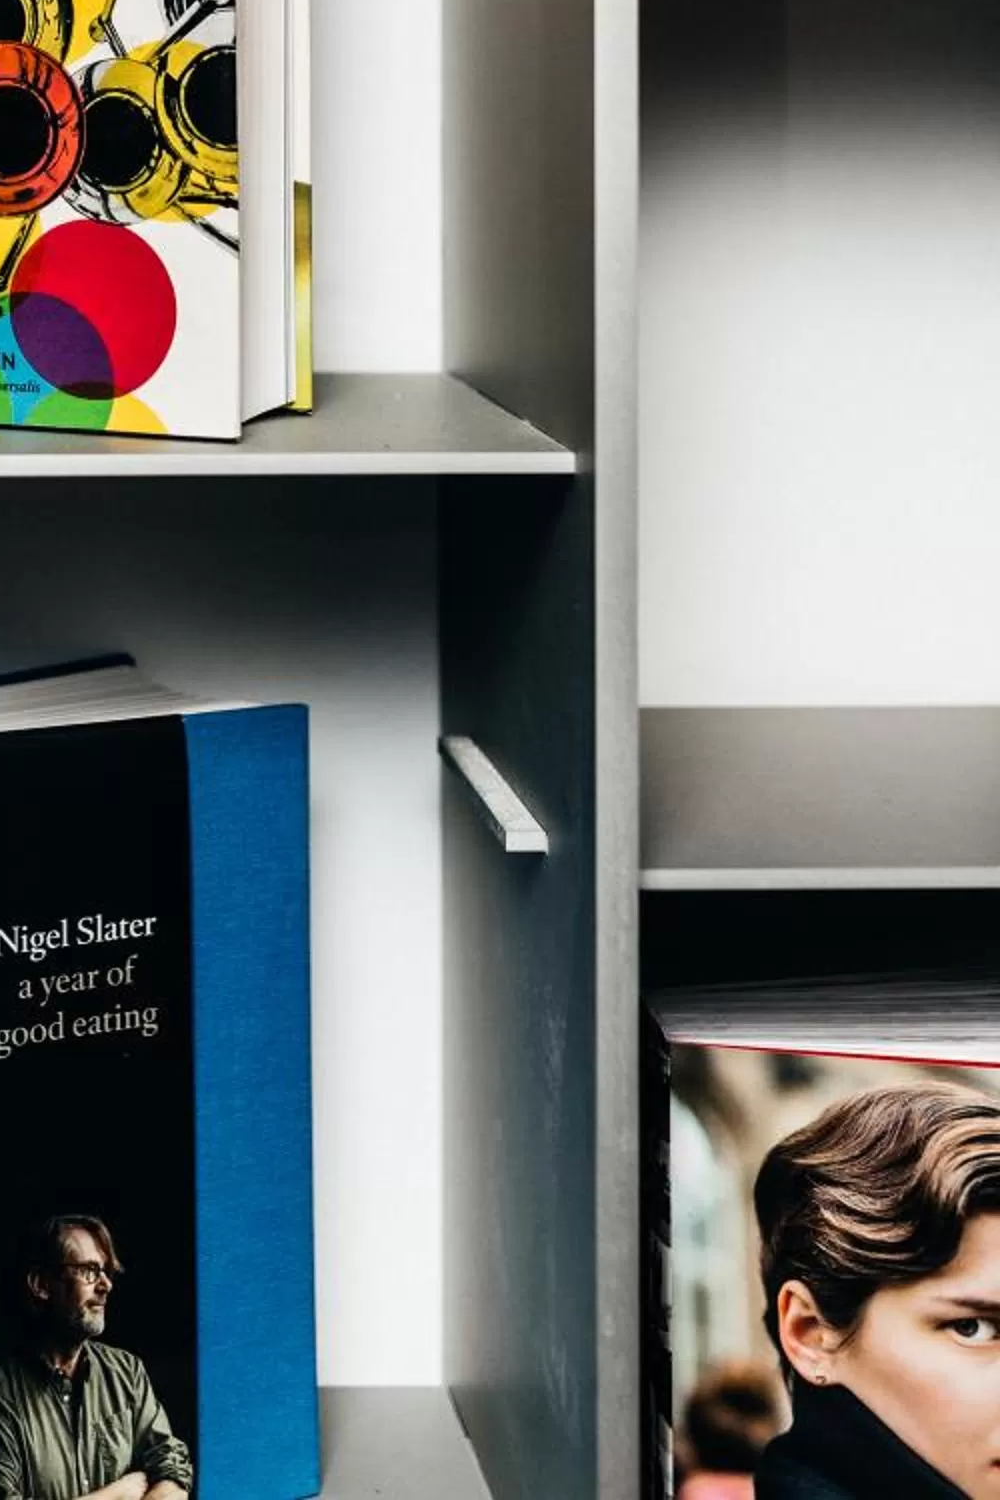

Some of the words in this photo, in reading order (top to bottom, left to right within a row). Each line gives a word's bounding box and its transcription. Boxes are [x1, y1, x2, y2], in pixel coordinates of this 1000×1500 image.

[76, 913, 157, 946] Slater
[18, 978, 34, 1000] a
[39, 969, 99, 1007] year
[106, 953, 139, 987] of
[72, 1004, 159, 1037] eating
